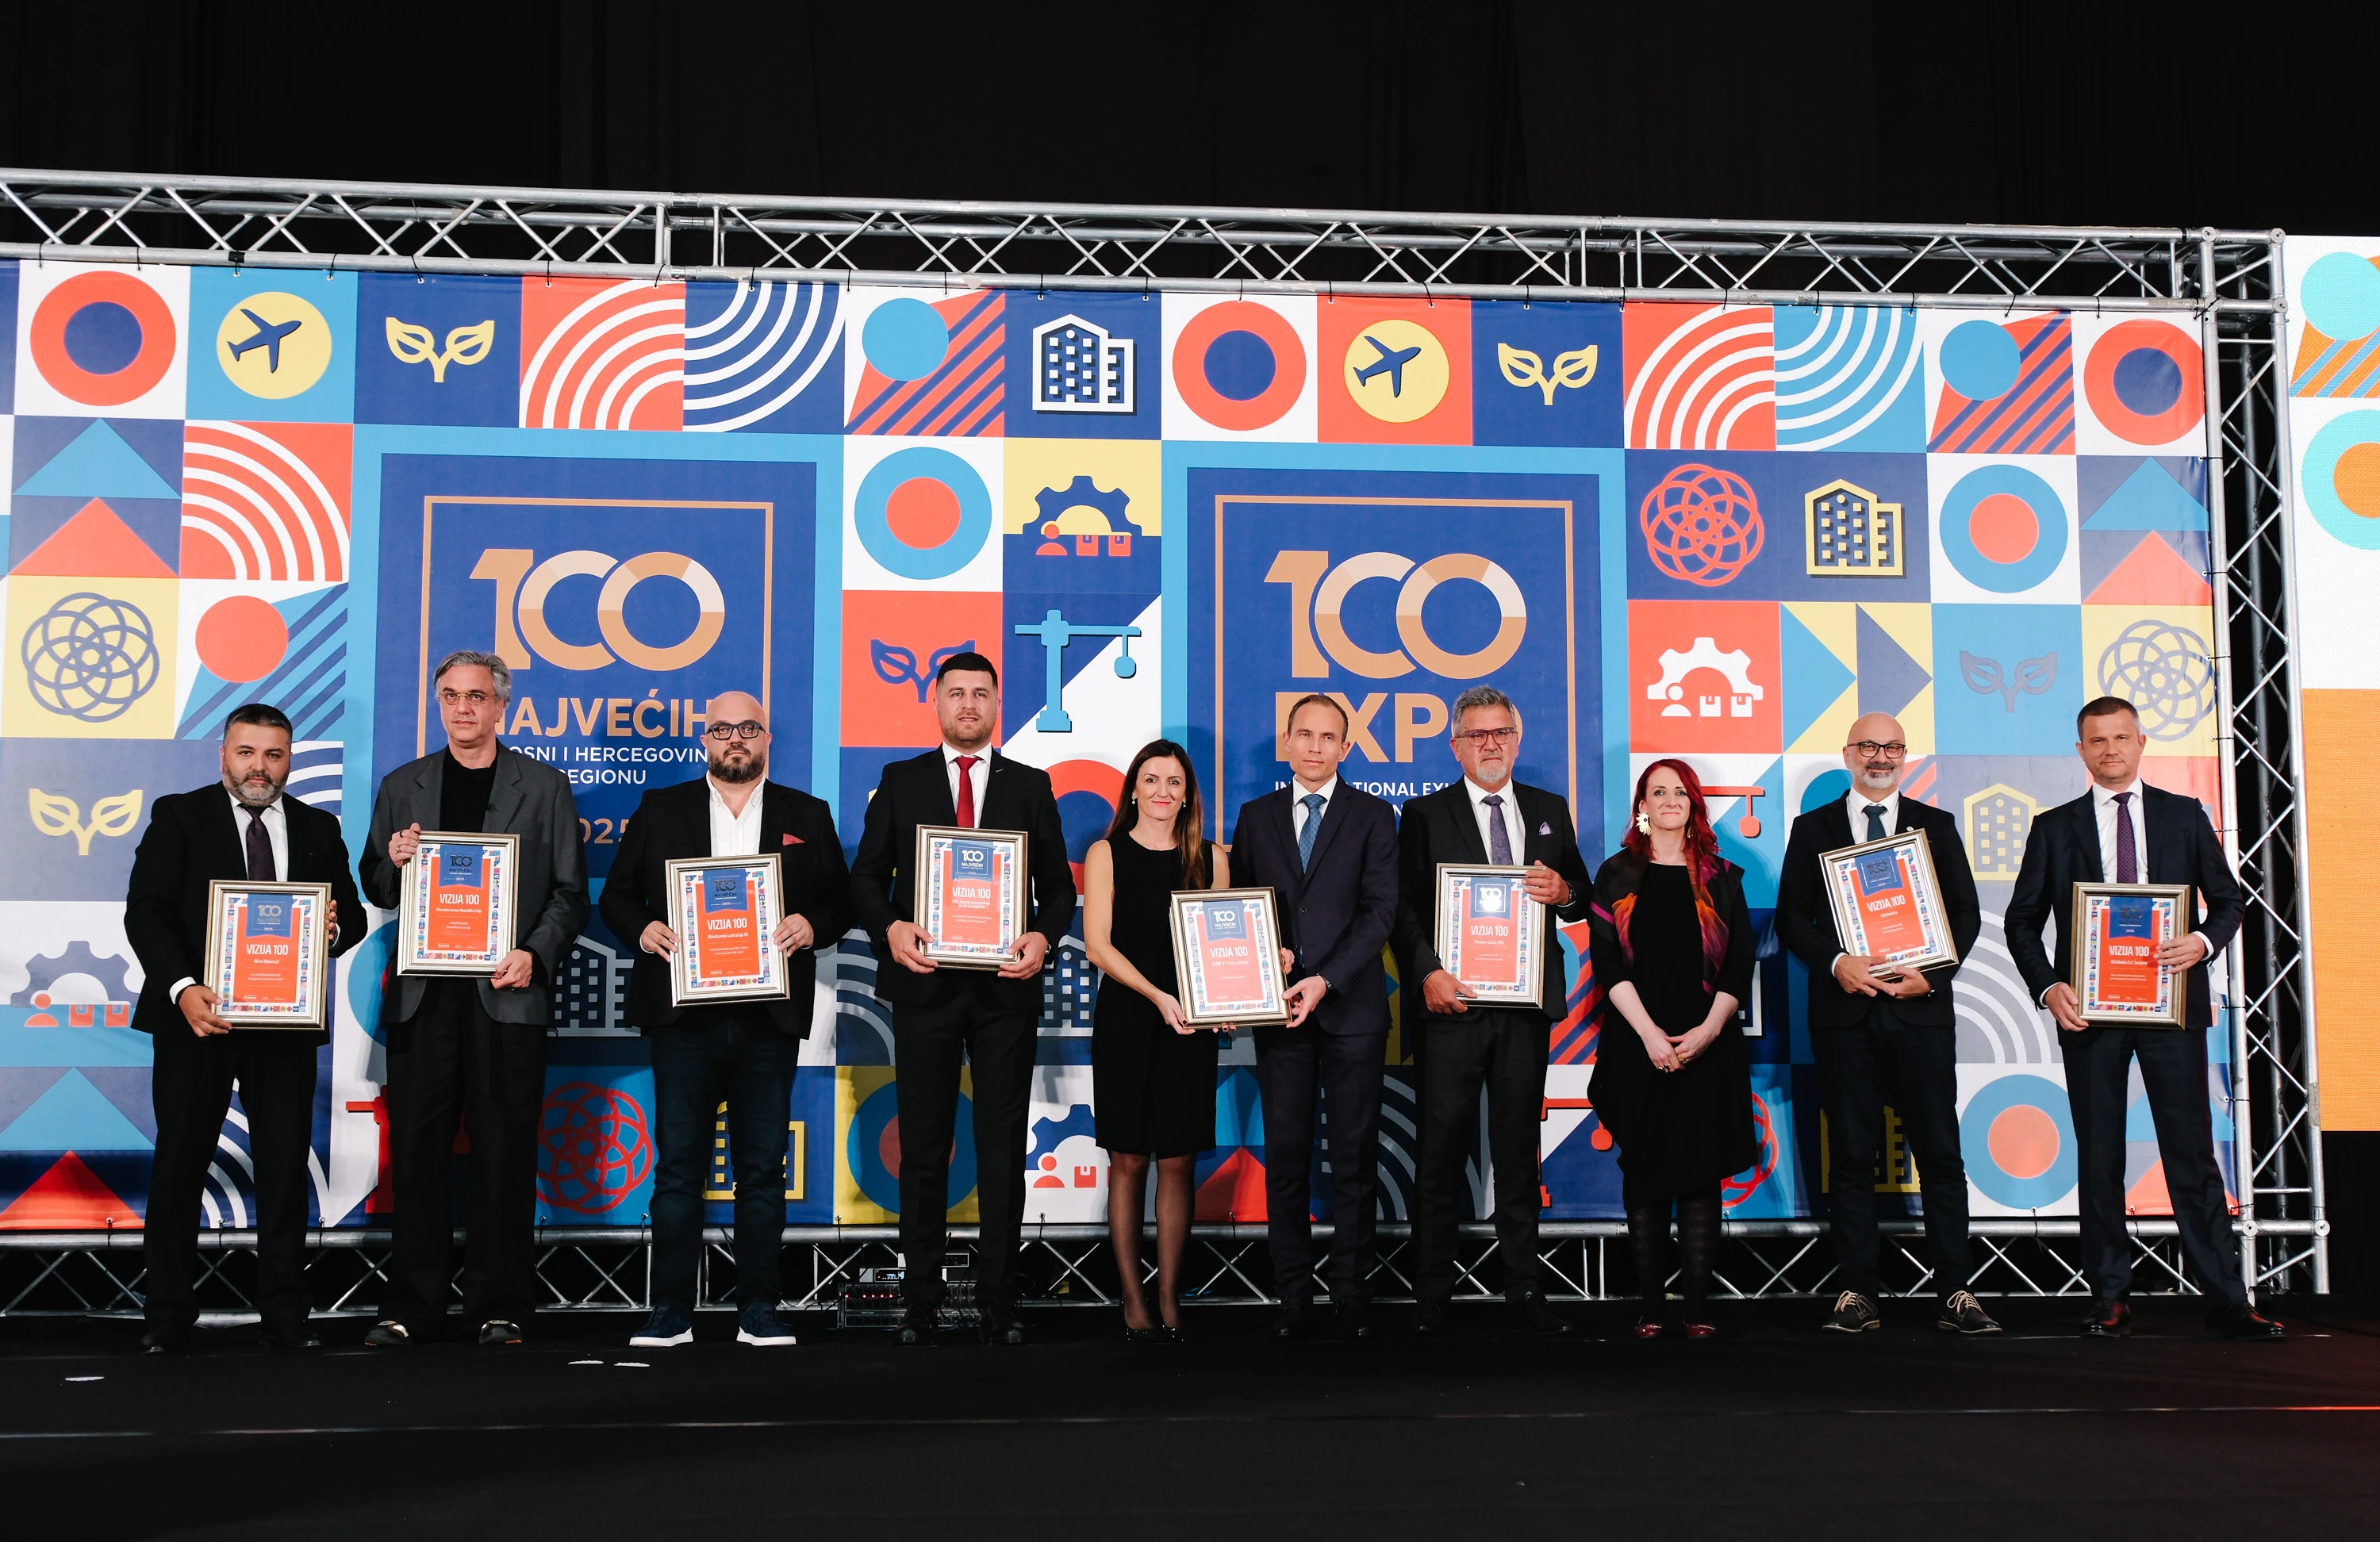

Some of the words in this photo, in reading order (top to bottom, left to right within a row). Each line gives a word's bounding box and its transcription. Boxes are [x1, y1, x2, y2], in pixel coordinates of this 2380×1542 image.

[470, 549, 725, 671] 100
[1264, 550, 1526, 679] 100
[1276, 692, 1522, 763] EXP
[509, 746, 555, 761] OSNI
[563, 746, 568, 761] I
[575, 747, 708, 763] HERCEGOVIN
[558, 769, 647, 784] EGIONU
[962, 850, 984, 862] 100
[440, 893, 463, 905] VIZIJA
[465, 894, 479, 905] 100
[952, 887, 976, 898] VIZIJA
[977, 888, 991, 899] 100
[1867, 899, 1891, 912] VIZIJA
[1891, 895, 1906, 907] 100
[257, 905, 282, 918] 100
[1213, 910, 1235, 923] 100
[707, 919, 731, 930] VIZIJA
[733, 918, 747, 929] 100
[1470, 926, 1493, 936] VIZIJA
[1495, 926, 1509, 937] 100
[246, 944, 271, 955] VIZIJA
[274, 945, 289, 956] 100
[1210, 947, 1234, 958] VIZIJA
[1234, 946, 1249, 957] 100
[2109, 945, 2133, 956] VIZIJA
[2134, 946, 2150, 957] 100
